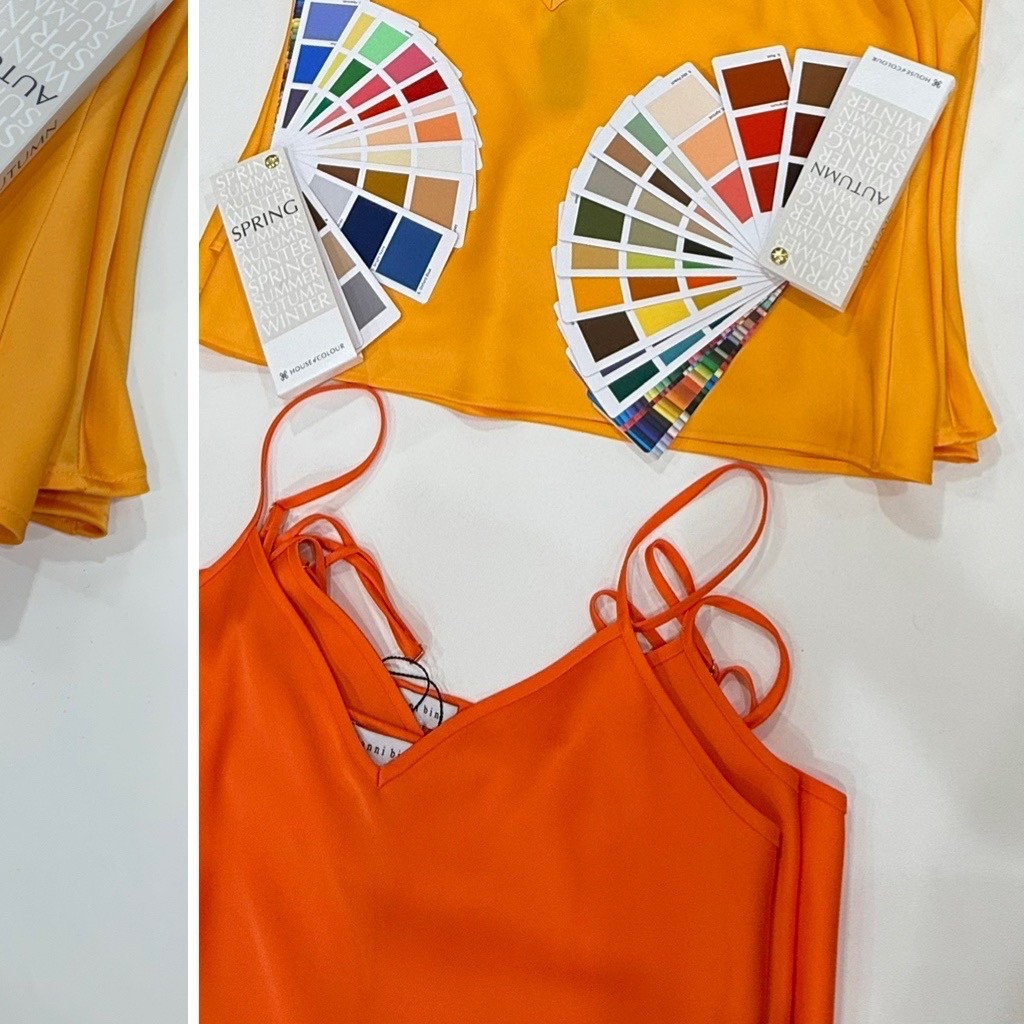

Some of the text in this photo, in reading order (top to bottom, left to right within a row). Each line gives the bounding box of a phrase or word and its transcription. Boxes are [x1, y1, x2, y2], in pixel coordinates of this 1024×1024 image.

[838, 105, 918, 149] AUTUMN
[844, 91, 925, 136] WINTER
[823, 129, 905, 179] SPRING
[832, 117, 911, 163] SUMMER
[215, 157, 267, 189] SPRIN
[219, 164, 286, 201] SUMMER
[809, 160, 889, 208] AUTUMN
[816, 146, 896, 193] WINTER
[223, 174, 289, 213] AUTUMN
[227, 185, 293, 225] WINTER
[794, 186, 876, 238] SPRING
[802, 173, 883, 222] SUMMER
[230, 198, 298, 242] SPRING
[234, 211, 303, 254] SUMMER
[781, 217, 860, 267] AUTUMN
[787, 202, 867, 253] WINTER
[239, 224, 306, 266] AUTUMN
[242, 235, 311, 280] WINTER
[774, 230, 853, 283] SUMMER
[246, 249, 317, 297] SPRING
[252, 264, 321, 309] SUMMER
[783, 252, 846, 298] SPRIN
[256, 278, 325, 323] AUTUMN
[261, 291, 330, 338] WINTER
[423, 705, 442, 720] bin
